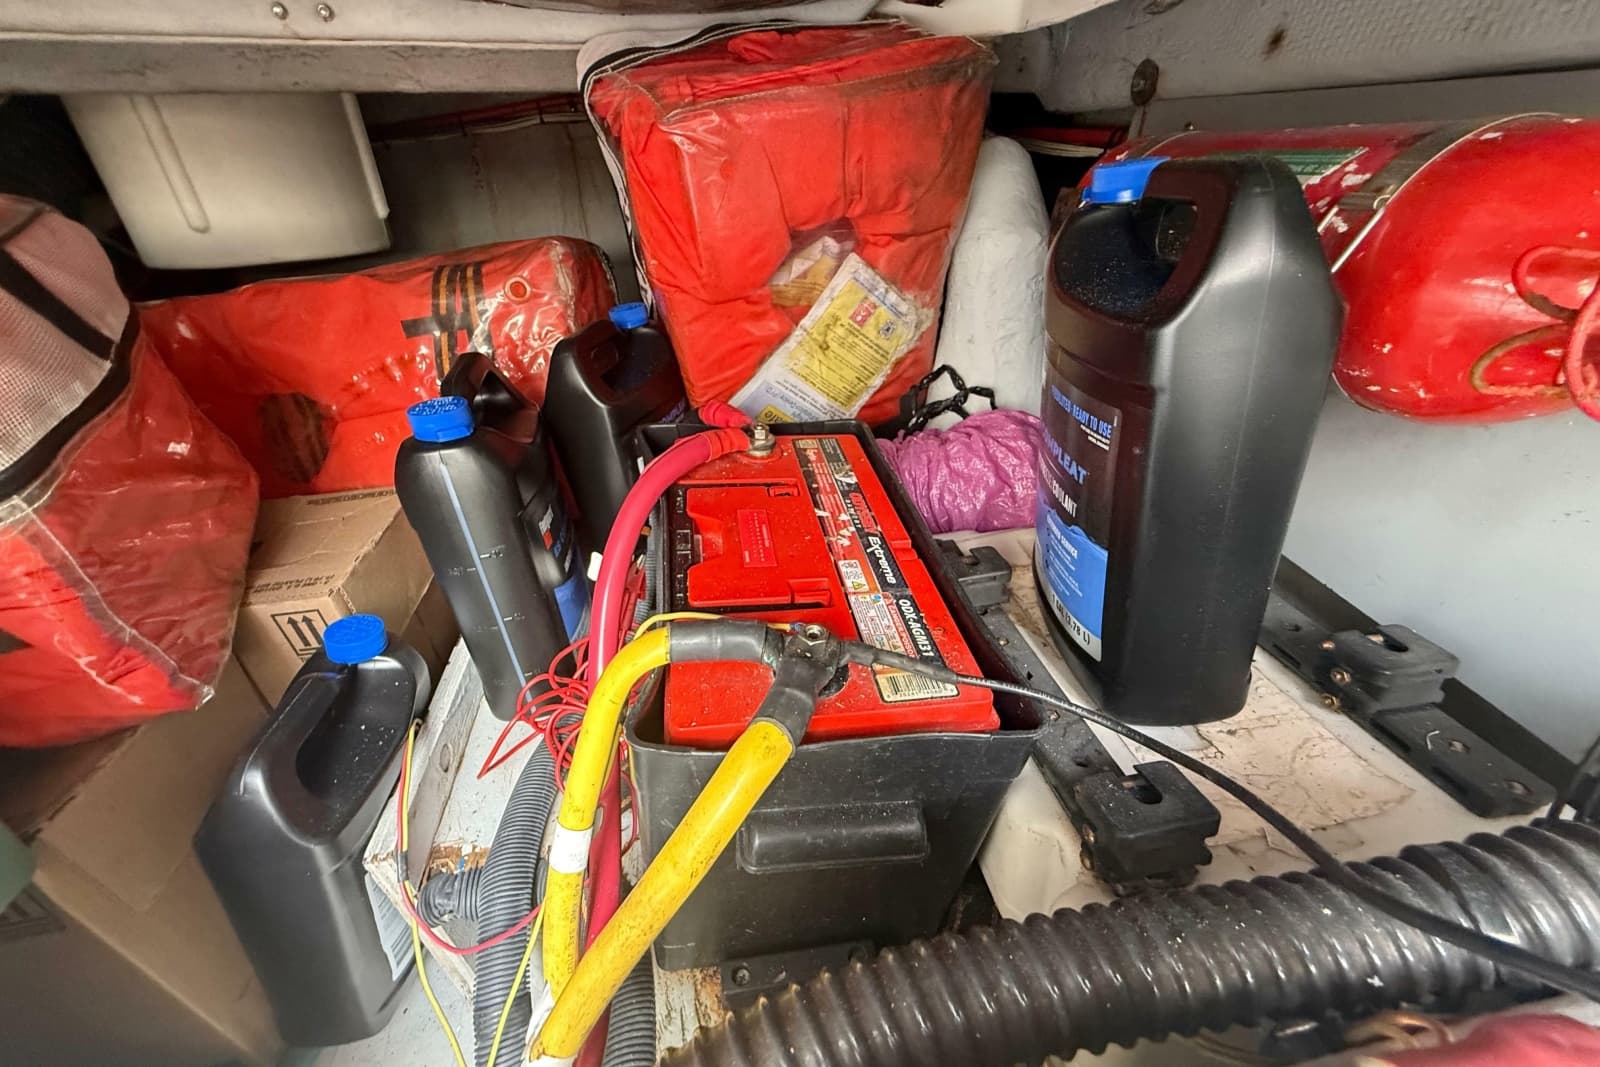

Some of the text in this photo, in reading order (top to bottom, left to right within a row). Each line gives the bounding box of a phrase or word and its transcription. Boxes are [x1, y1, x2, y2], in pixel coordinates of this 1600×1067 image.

[1090, 414, 1098, 431] TO
[1099, 419, 1112, 438] USE
[866, 535, 897, 584] Extreme
[898, 598, 935, 657] ODX-AGM31
[1082, 630, 1091, 646] L)
